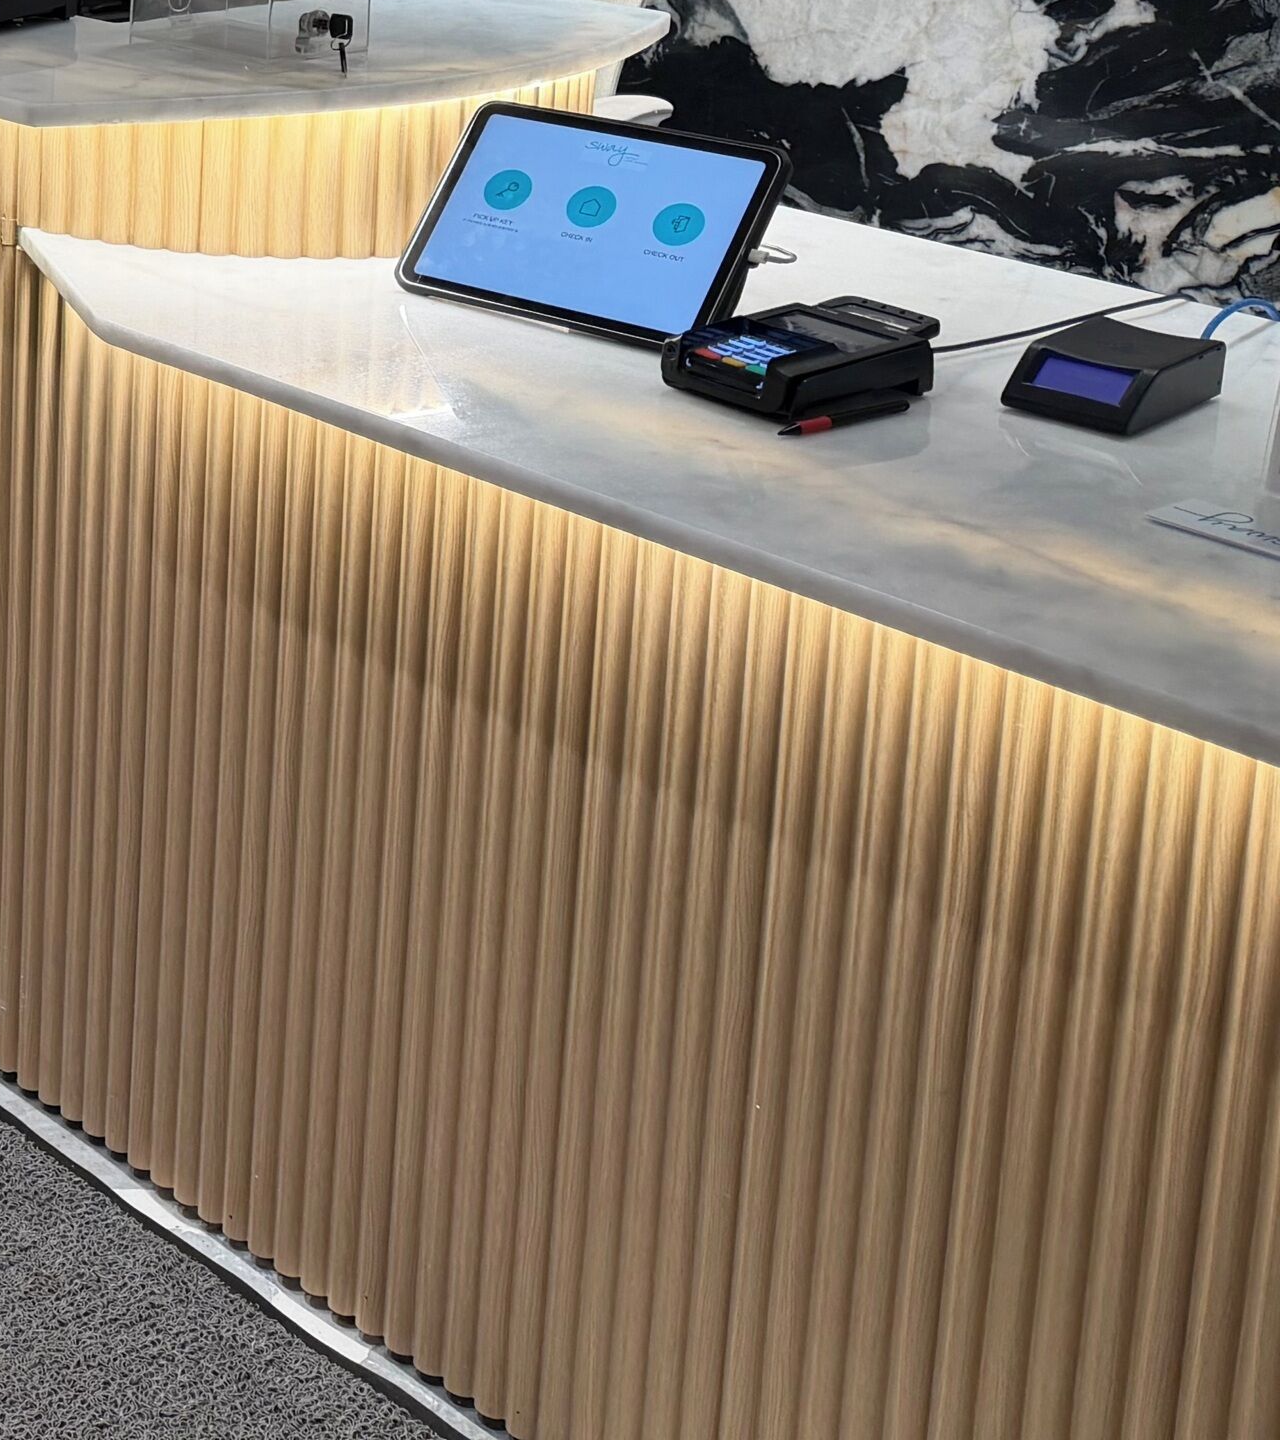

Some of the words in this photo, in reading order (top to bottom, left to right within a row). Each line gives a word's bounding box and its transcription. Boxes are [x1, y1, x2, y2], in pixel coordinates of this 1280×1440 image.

[560, 231, 584, 242] CHECK
[585, 235, 593, 243] IN
[643, 248, 668, 260] CHECK
[669, 253, 685, 263] OUT
